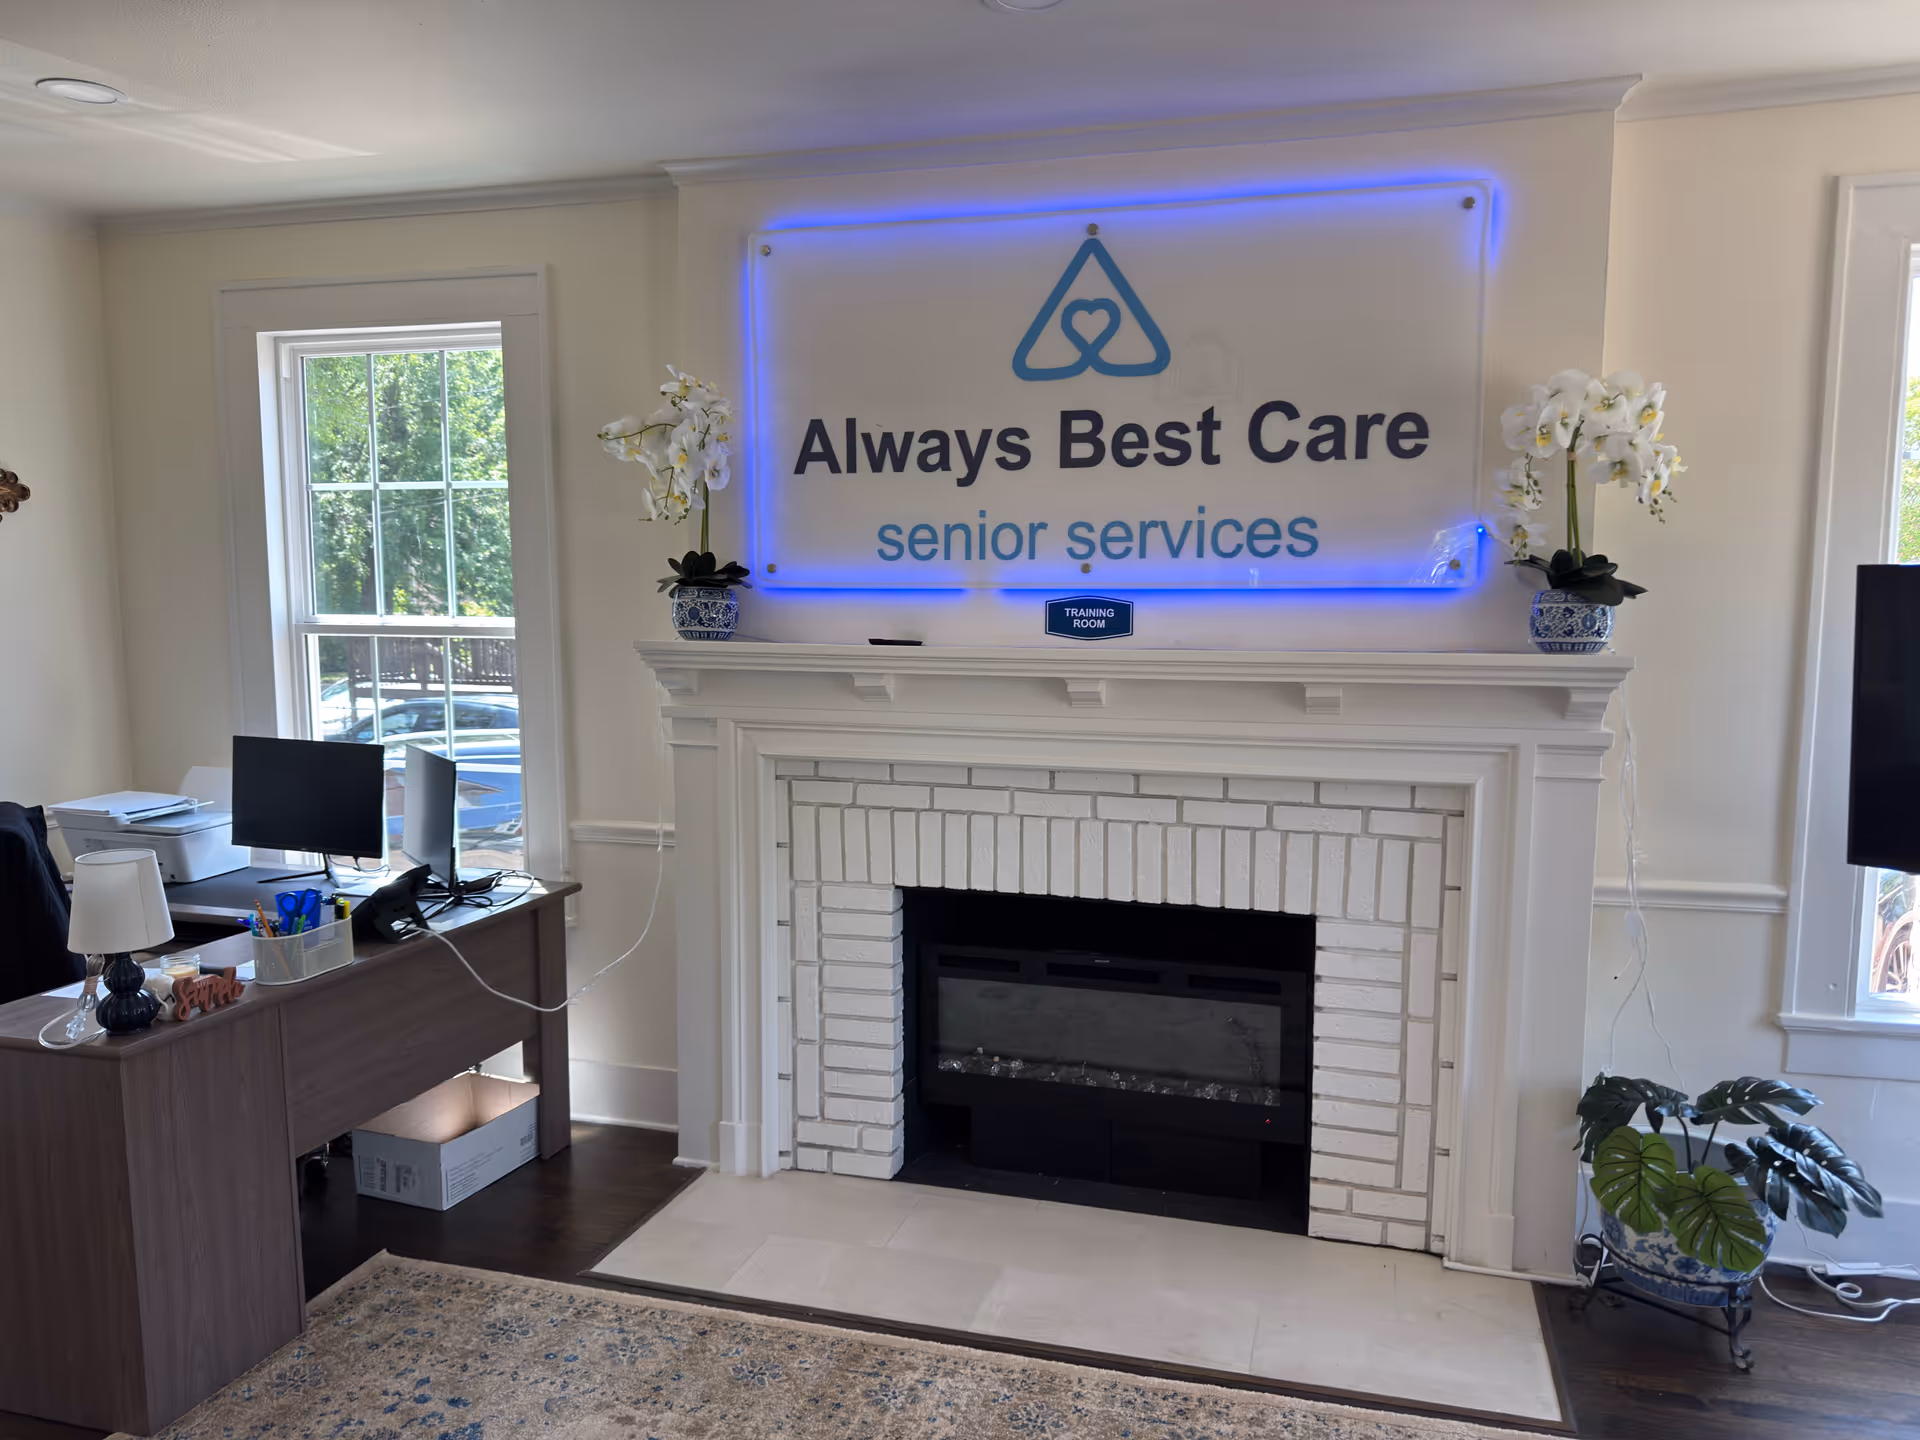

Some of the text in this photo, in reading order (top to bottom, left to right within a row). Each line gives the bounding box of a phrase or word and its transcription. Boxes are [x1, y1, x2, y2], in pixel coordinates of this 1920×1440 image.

[793, 399, 1430, 488] Always Best Care
[877, 505, 1319, 562] senior services
[1064, 607, 1115, 618] TRAINING
[1073, 619, 1106, 629] ROOM
